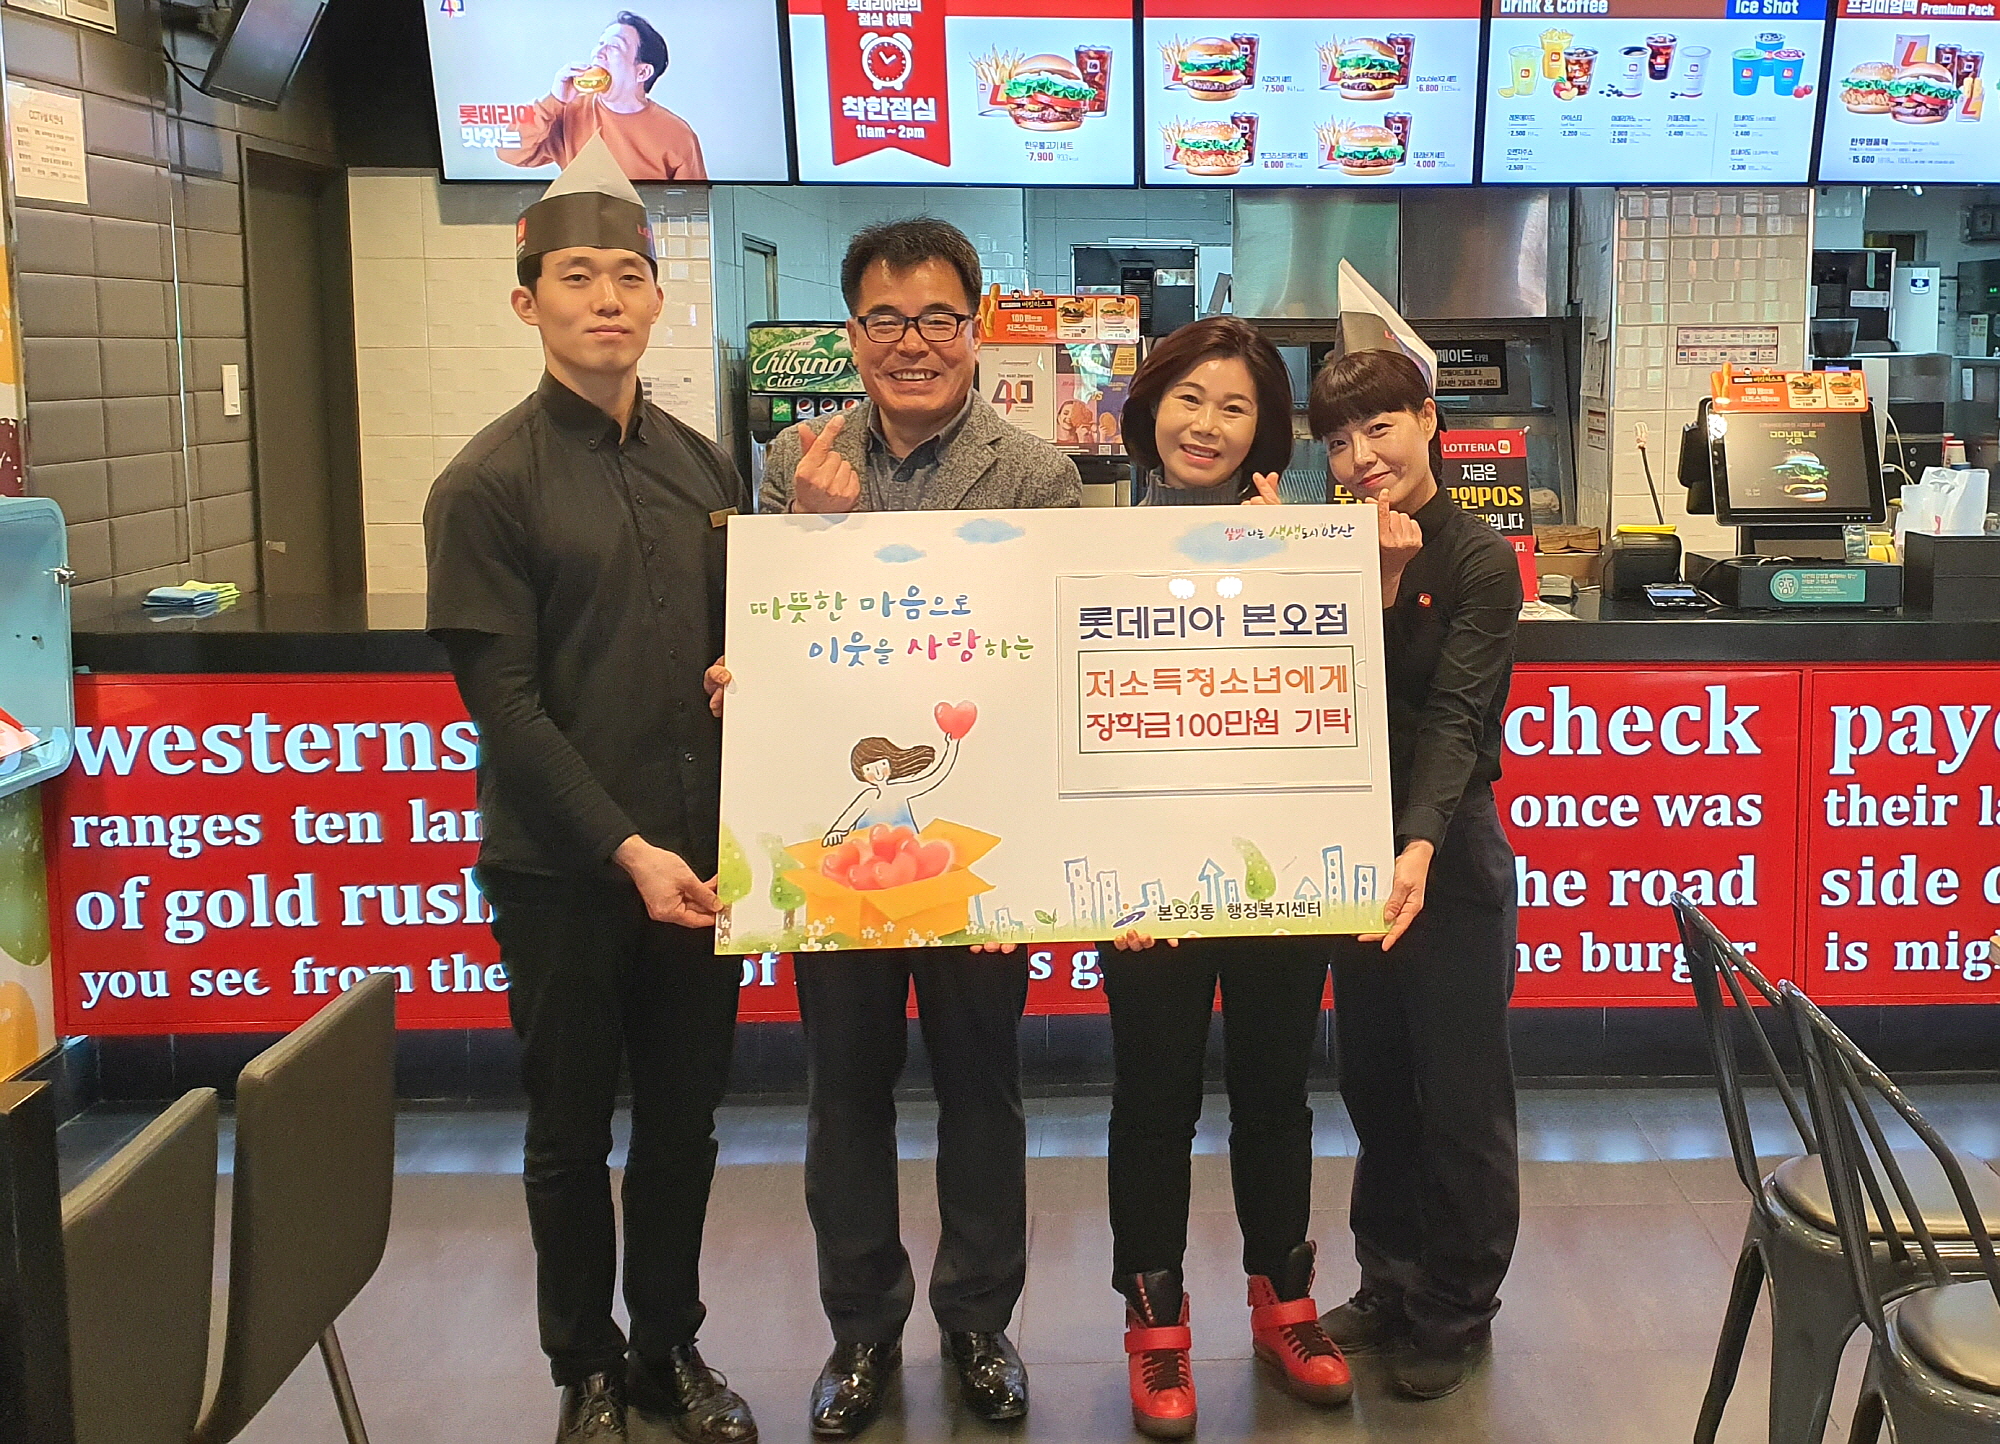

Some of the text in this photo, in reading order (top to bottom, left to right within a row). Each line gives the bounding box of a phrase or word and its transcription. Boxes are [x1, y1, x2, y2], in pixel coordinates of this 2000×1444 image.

[858, 12, 912, 27] 점심 혜택
[1501, 0, 1541, 14] Drink
[1556, 0, 1608, 14] Coffee
[1735, 0, 1799, 14] Ice Shot
[1921, 2, 1966, 16] Premium
[1967, 3, 1995, 16] Pack
[842, 96, 936, 121] 착한점심
[461, 126, 521, 149] 맛있는
[751, 349, 848, 379] Chilsung
[767, 374, 814, 389] Cider
[1443, 443, 1497, 453] LOTTERIA
[1461, 464, 1498, 482] 지금은
[1320, 522, 1356, 539] 안산
[750, 585, 972, 624] 따뜻한 마음으로
[1079, 602, 1349, 640] 롯데리아 본오점
[808, 628, 1035, 668] 이웃을 사랑하는
[1085, 664, 1348, 698] 저소득청소년에게
[1086, 707, 1352, 742] 장학금100만원 기탁
[1503, 685, 1762, 756] check
[74, 712, 481, 776] westerns
[1829, 704, 2000, 774] pay
[1510, 794, 1762, 828] once was
[1824, 784, 1958, 827] their
[71, 813, 262, 859] ranges
[291, 805, 383, 844] ten
[1609, 855, 1758, 908] road
[1820, 854, 1959, 907] side
[75, 874, 152, 931] of
[164, 873, 319, 945] gold
[1157, 900, 1322, 922] 본오3동 행정복지센터
[1825, 931, 1868, 971] is
[80, 967, 171, 1009] you
[427, 953, 512, 993] the
